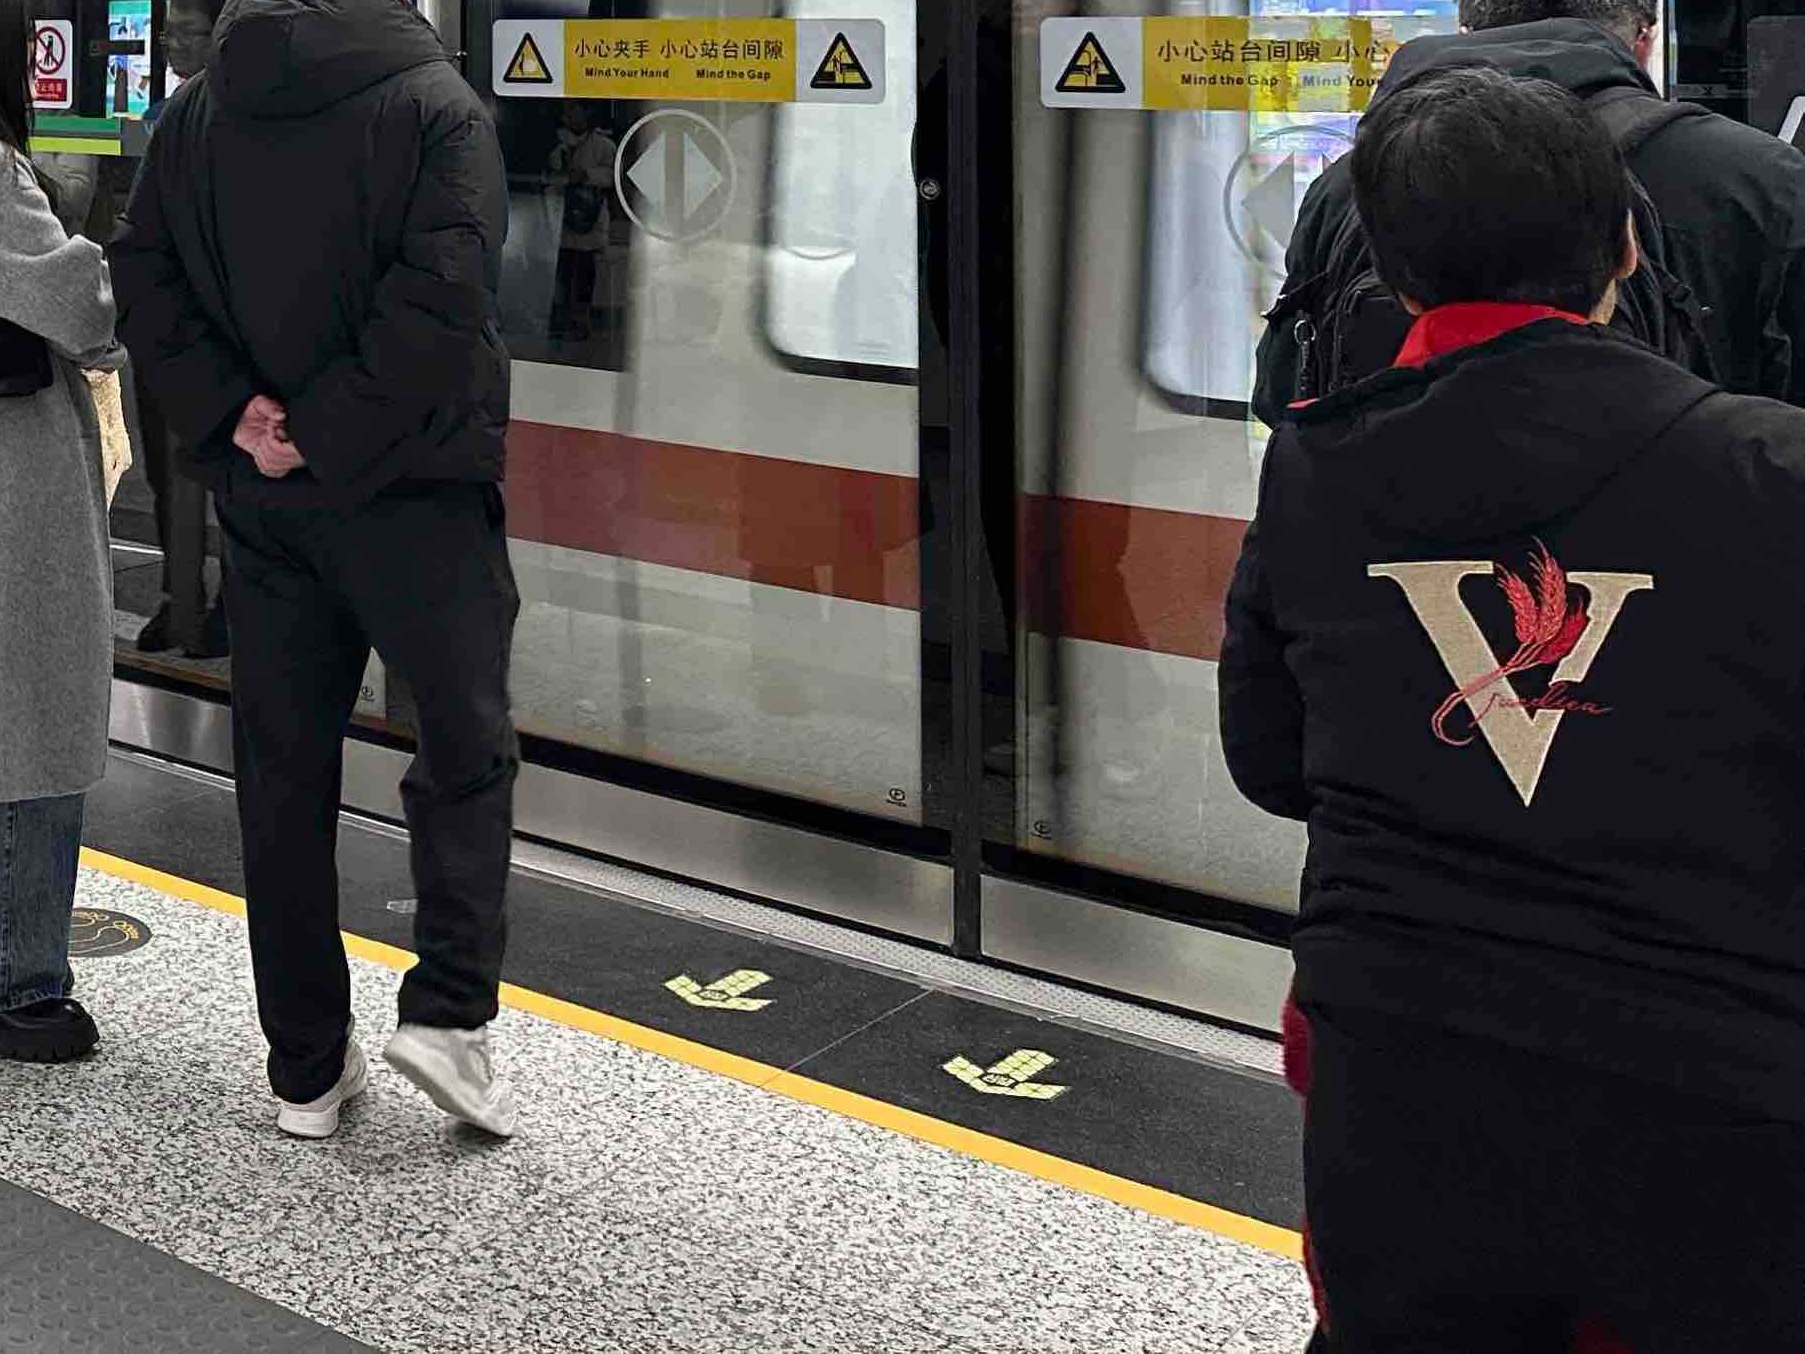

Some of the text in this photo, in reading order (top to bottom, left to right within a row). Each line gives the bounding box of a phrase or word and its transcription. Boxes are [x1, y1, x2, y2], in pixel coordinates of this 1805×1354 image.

[574, 38, 785, 60] 小心夹手 小心站台间隙
[1157, 38, 1321, 63] 小心站台间隙
[584, 67, 669, 79] Mind Your Hand
[696, 69, 771, 81] Mind the Gap
[1180, 73, 1217, 86] Mind
[1219, 73, 1245, 86] the
[1247, 74, 1278, 88] Gap
[1302, 74, 1342, 88] Mind
